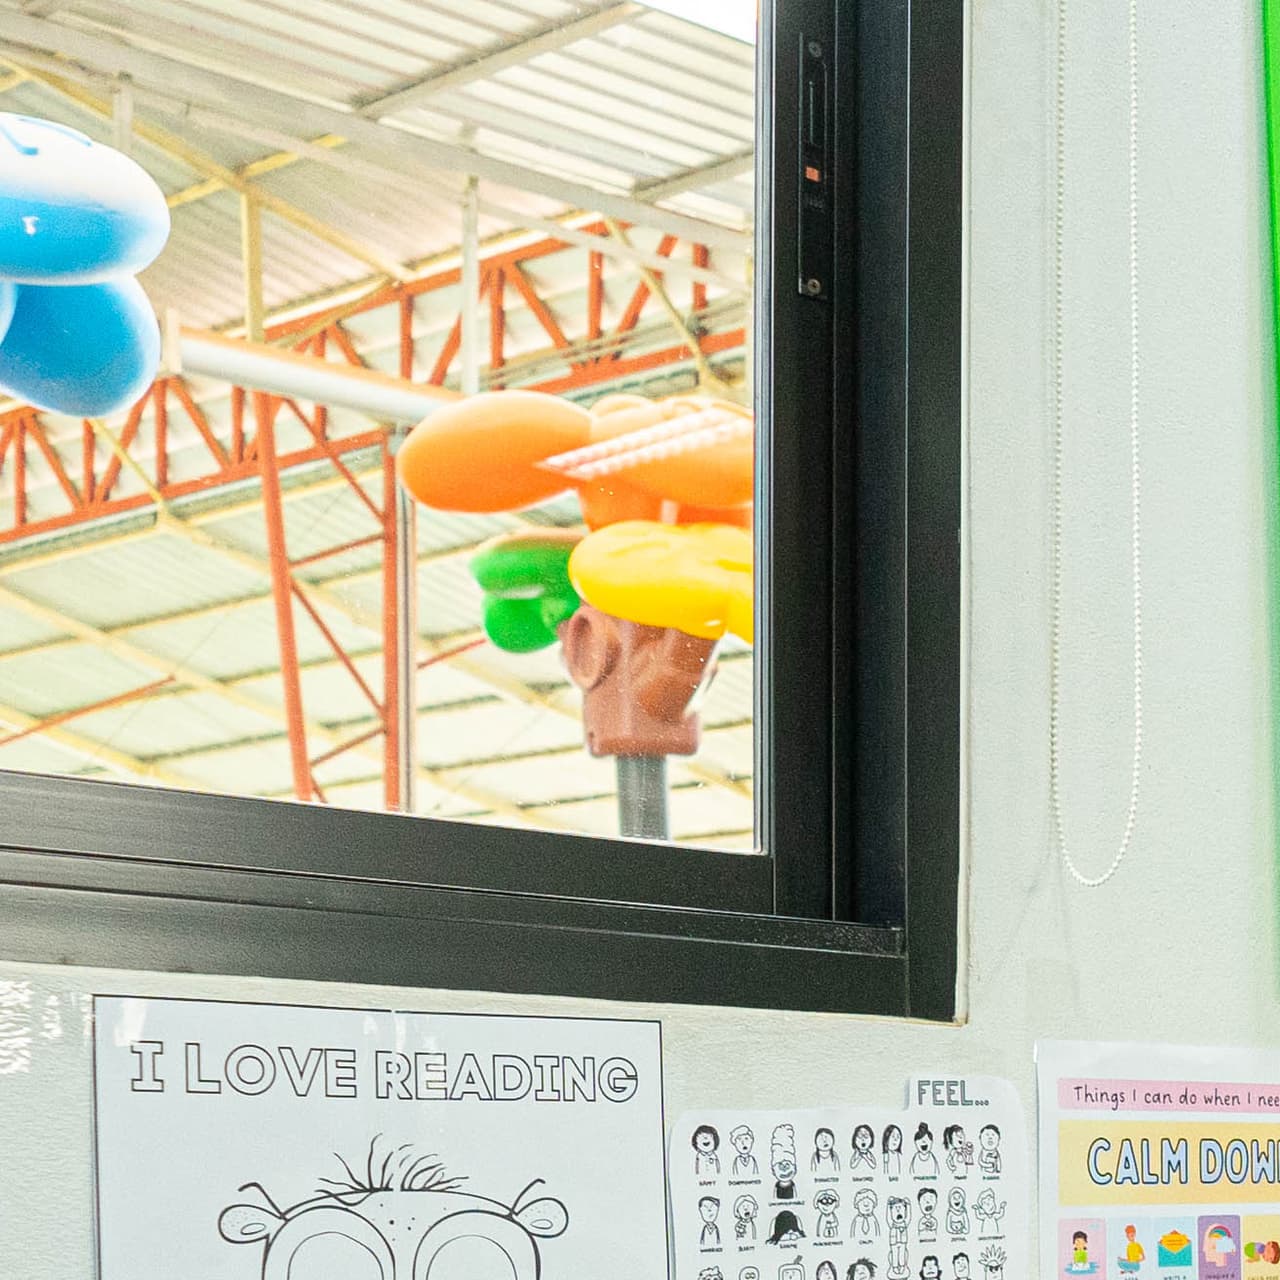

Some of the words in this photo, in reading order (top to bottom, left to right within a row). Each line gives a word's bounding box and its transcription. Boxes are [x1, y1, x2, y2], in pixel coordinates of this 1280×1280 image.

[130, 1040, 164, 1093] I
[184, 1042, 358, 1099] LOVE
[375, 1050, 640, 1103] READING
[1073, 1084, 1126, 1111] Things
[1132, 1089, 1137, 1101] I
[1144, 1092, 1173, 1105] can
[1179, 1088, 1198, 1105] do
[1203, 1088, 1241, 1106] when
[1087, 1137, 1189, 1185] CALM
